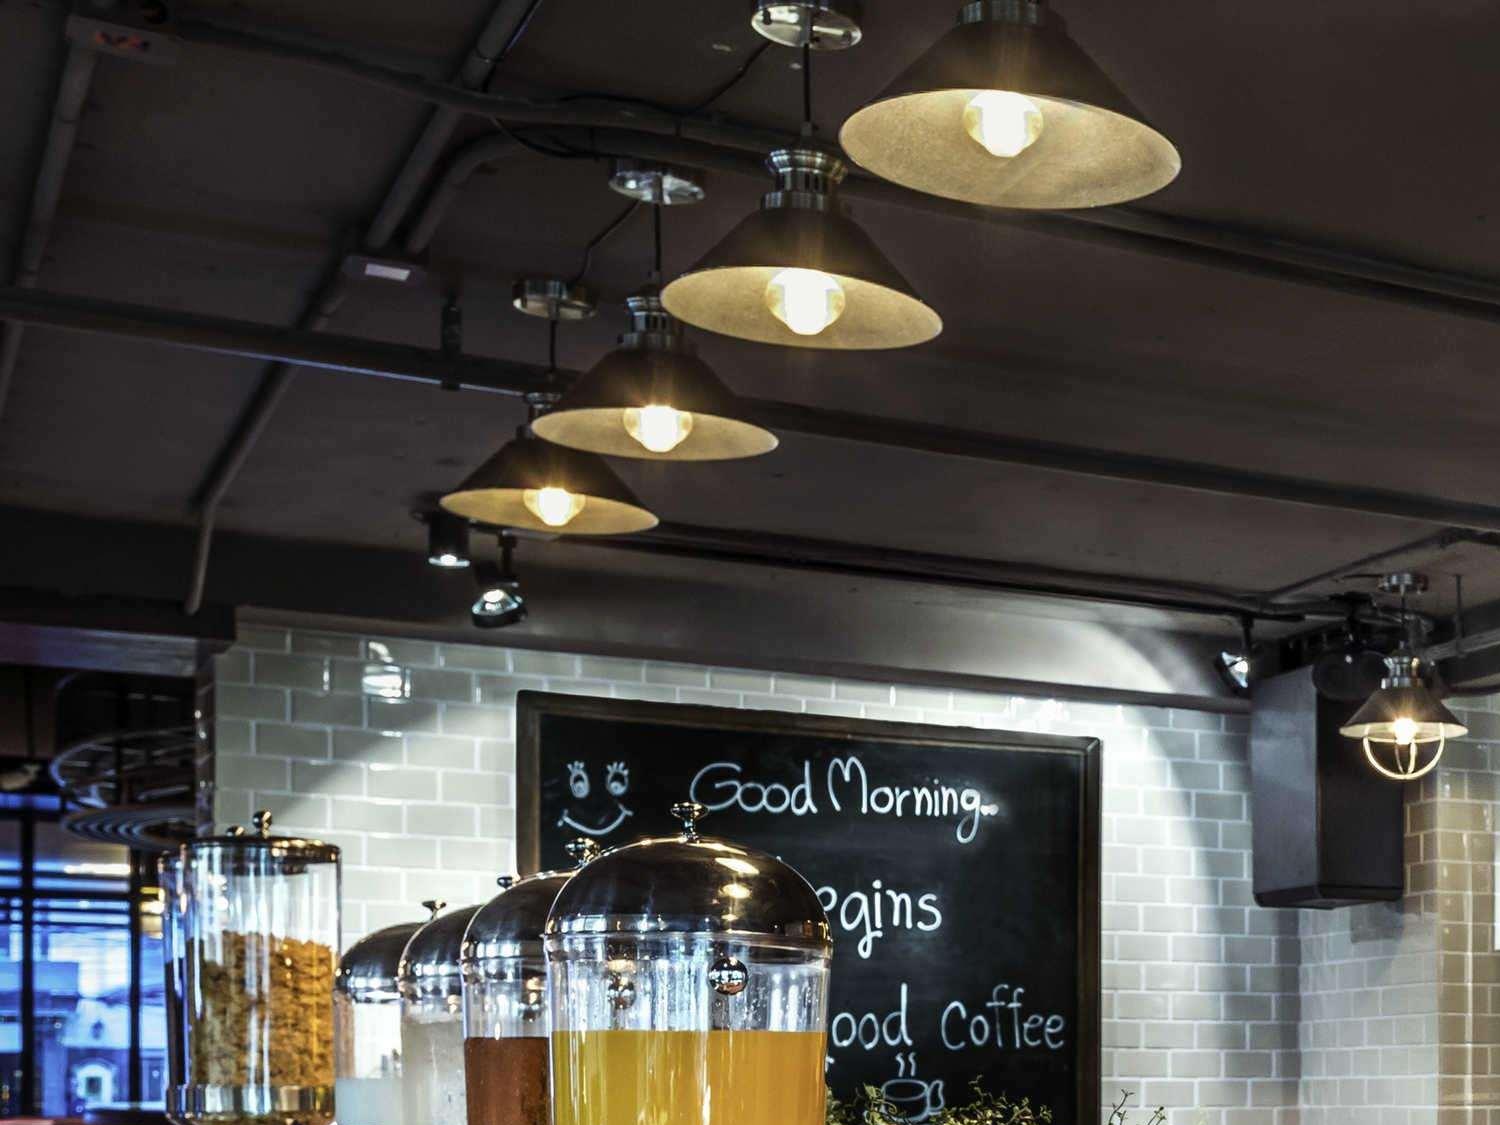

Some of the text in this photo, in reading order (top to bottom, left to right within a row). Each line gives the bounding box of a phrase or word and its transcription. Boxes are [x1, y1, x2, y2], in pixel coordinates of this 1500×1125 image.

[689, 760, 818, 816] Good
[816, 879, 943, 959] egins
[825, 982, 914, 1072] ood
